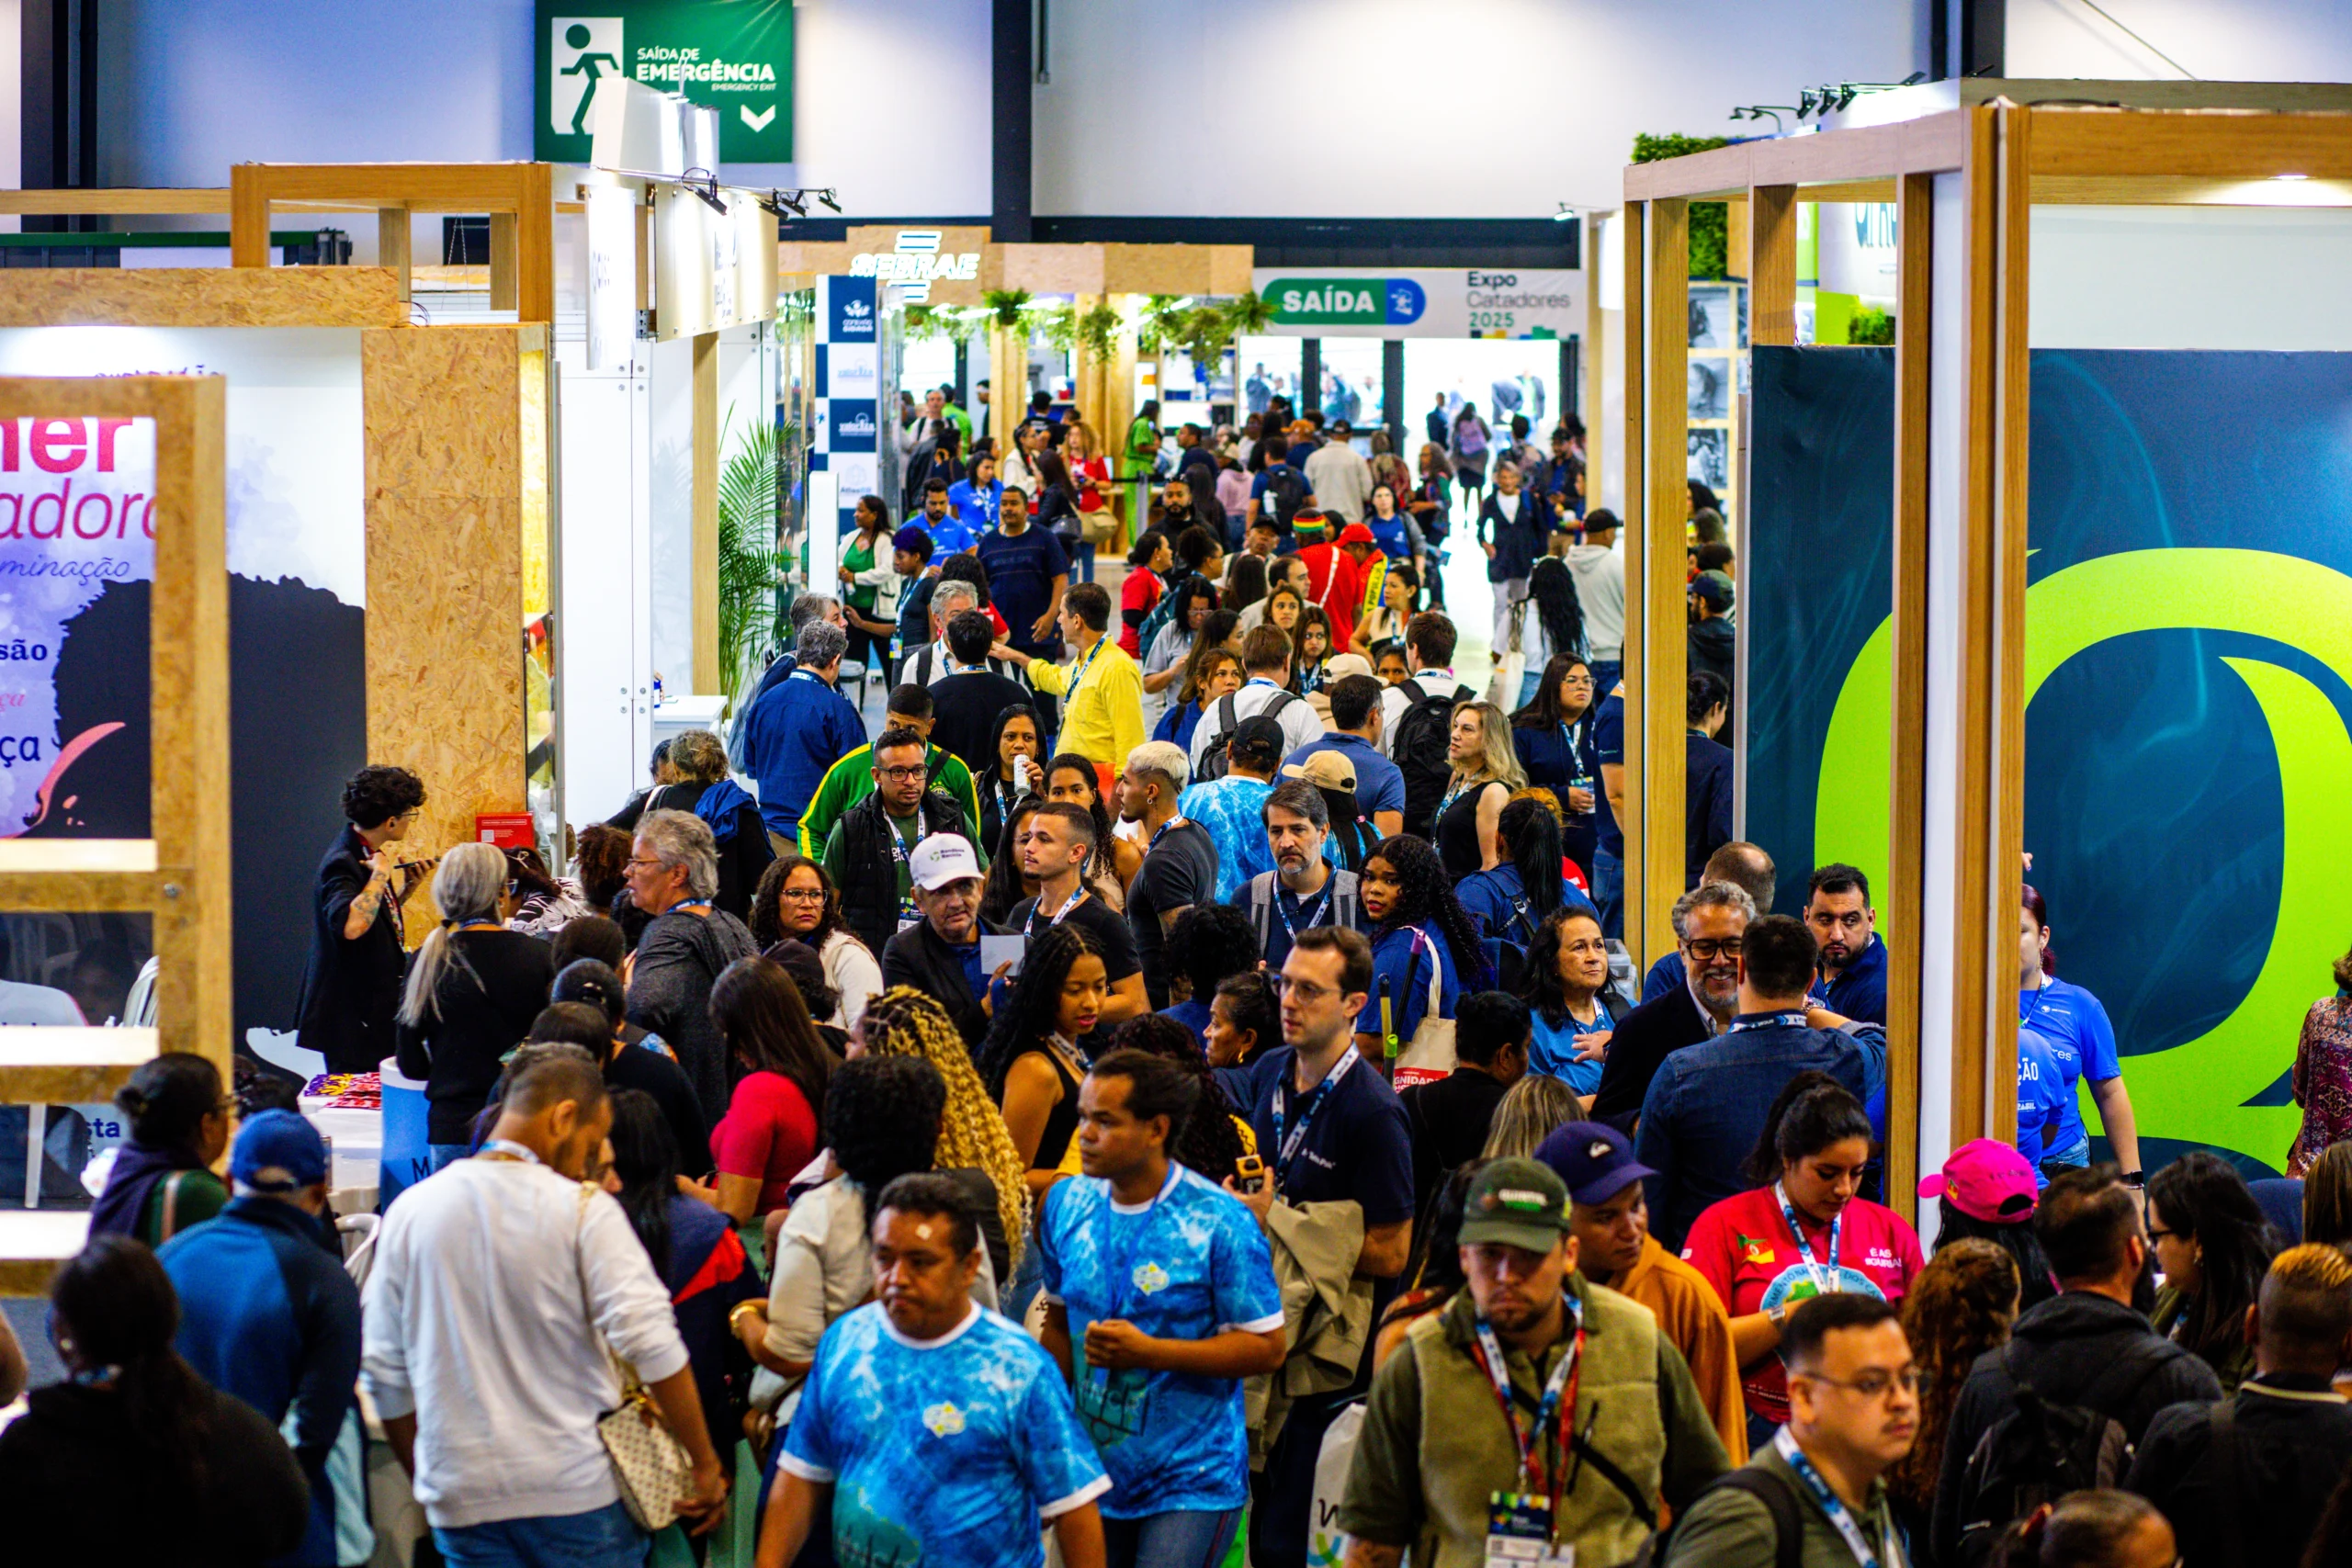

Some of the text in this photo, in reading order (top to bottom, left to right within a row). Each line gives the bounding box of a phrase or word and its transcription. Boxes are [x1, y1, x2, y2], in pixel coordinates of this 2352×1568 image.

[637, 45, 700, 61] SAÍDA DE
[636, 58, 776, 82] EMERGÊNCIA
[711, 83, 776, 91] EMERGENCY EXIT
[850, 253, 980, 280] SEBRAE
[1467, 271, 1518, 289] Expo
[1283, 285, 1375, 313] SAÍDA
[1467, 290, 1571, 310] Catadores
[1470, 312, 1515, 328] 2025
